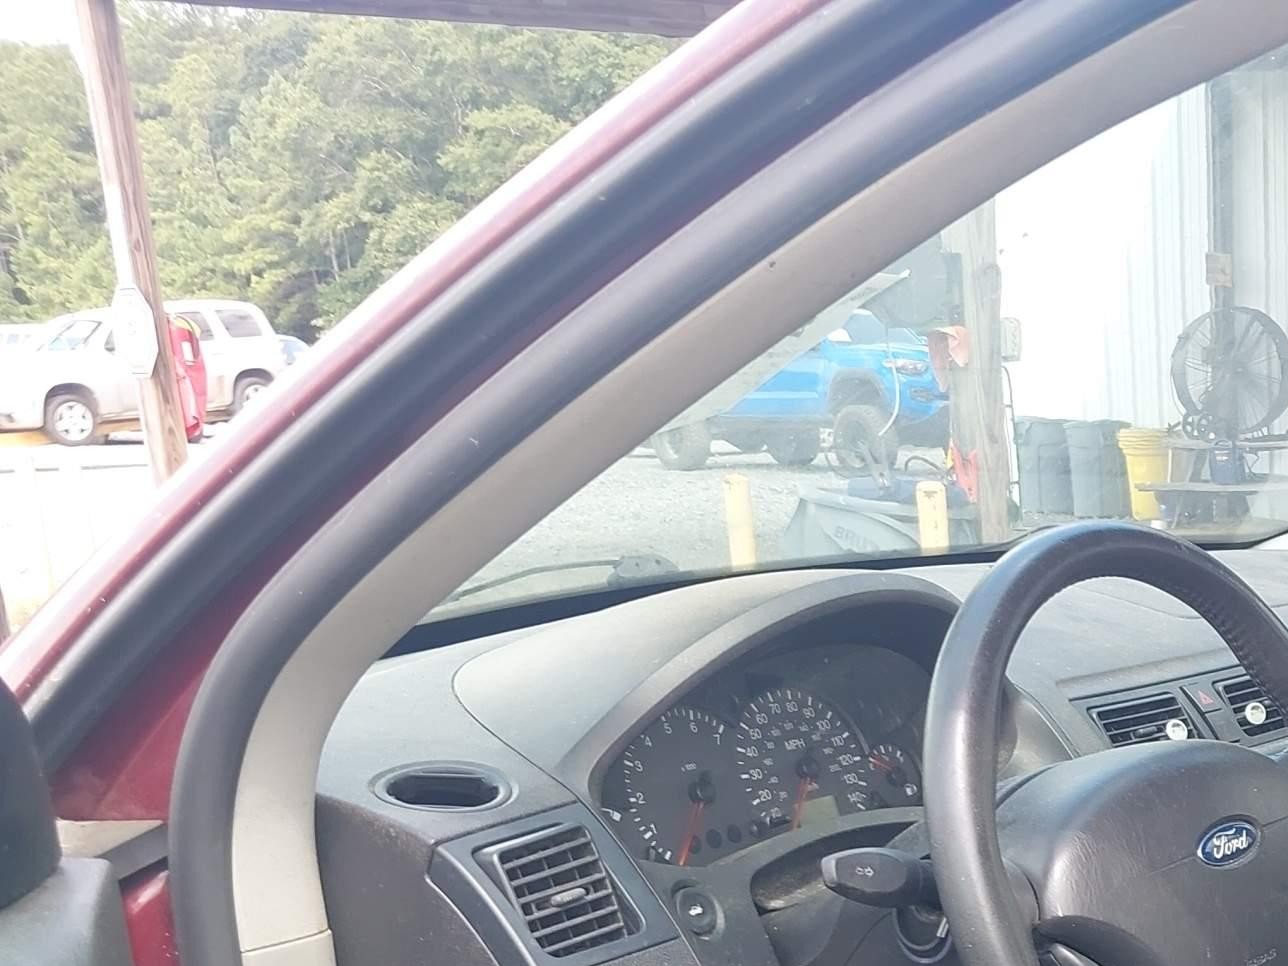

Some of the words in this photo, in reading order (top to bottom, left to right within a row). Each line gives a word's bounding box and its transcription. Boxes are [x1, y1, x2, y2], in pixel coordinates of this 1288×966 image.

[769, 703, 781, 714] 70
[756, 713, 768, 725] 60
[816, 719, 831, 731] 100
[664, 723, 672, 734] 5
[690, 722, 698, 733] 6
[644, 736, 652, 747] 4
[713, 734, 721, 745] 7
[784, 739, 806, 751] MPH
[634, 760, 643, 772] 3
[750, 769, 762, 780] 30
[636, 792, 646, 804] 2
[759, 789, 771, 801] 20
[1213, 828, 1248, 859] Ford
